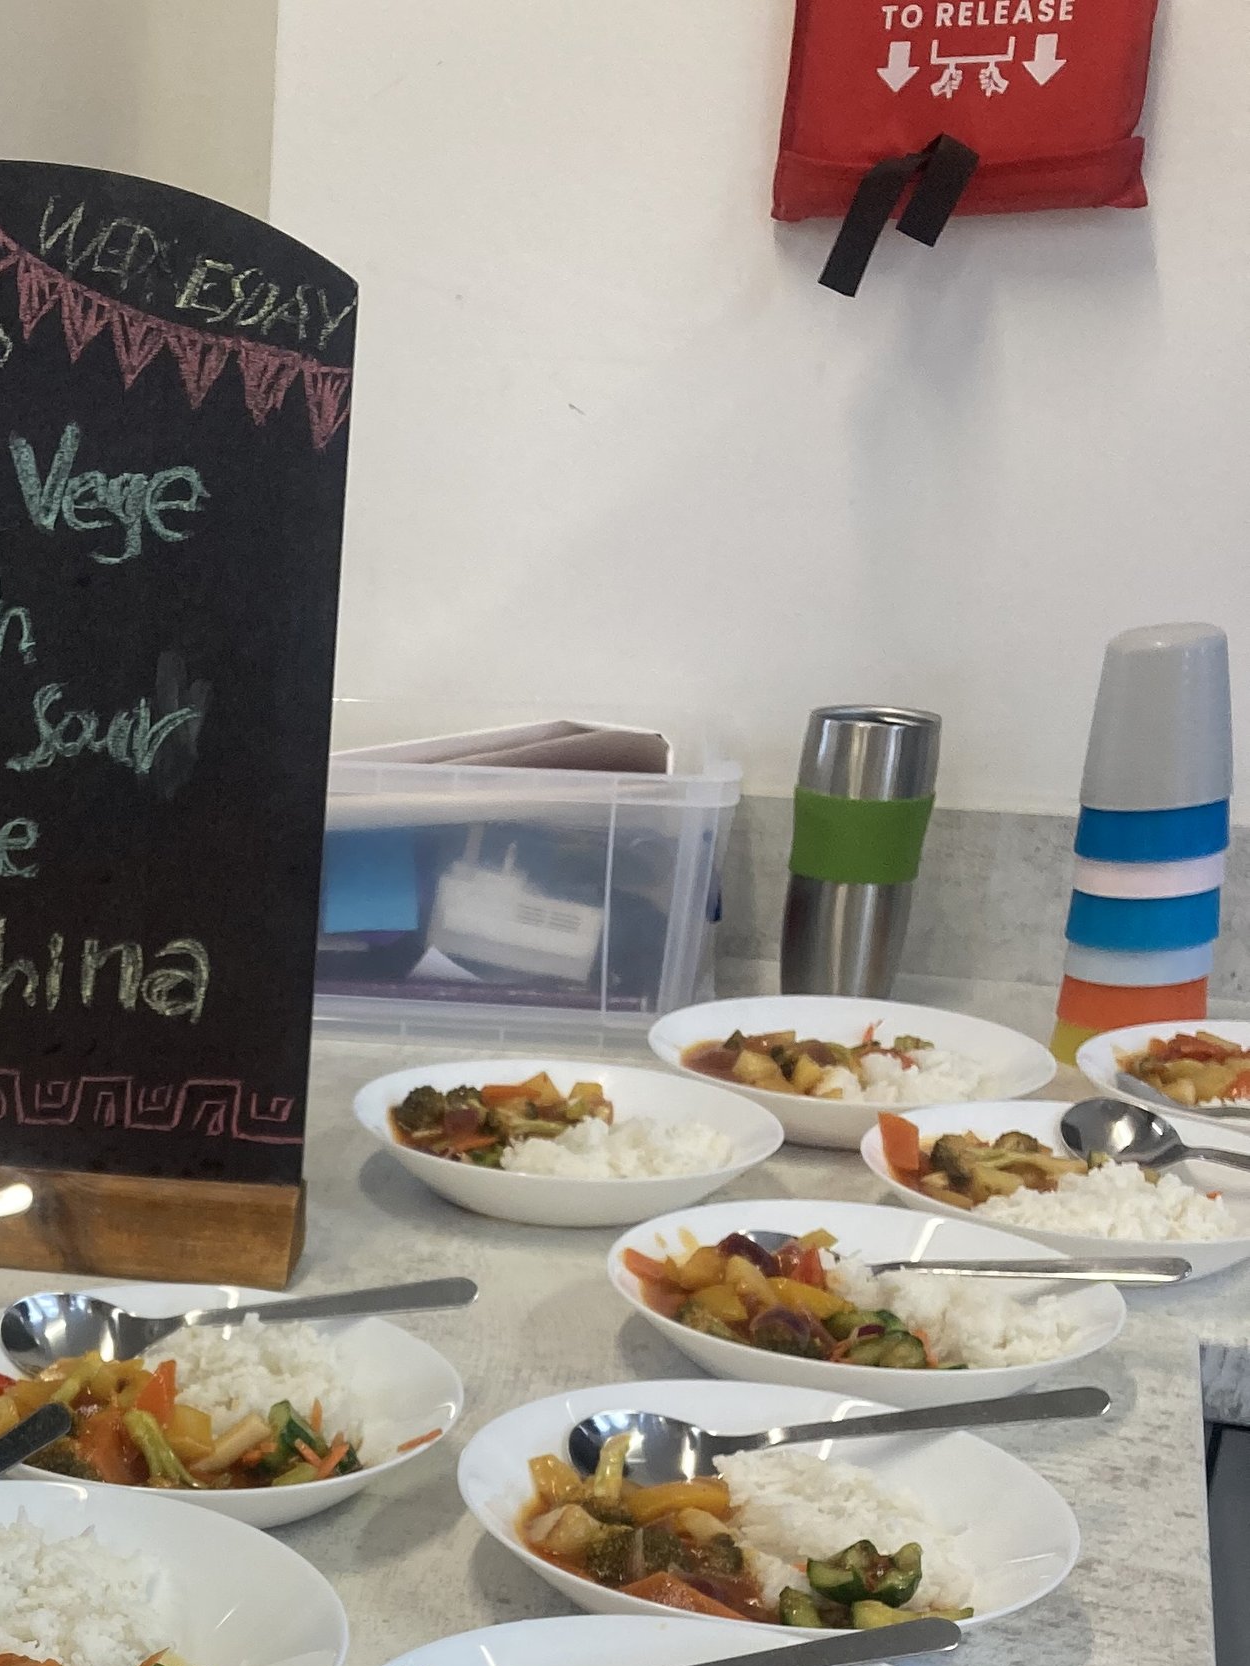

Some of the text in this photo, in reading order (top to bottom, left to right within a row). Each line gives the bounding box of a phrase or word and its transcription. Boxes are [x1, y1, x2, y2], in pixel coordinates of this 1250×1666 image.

[882, 0, 1076, 30] TO RELEASE
[9, 421, 210, 566] Vege
[6, 682, 198, 774] Sour
